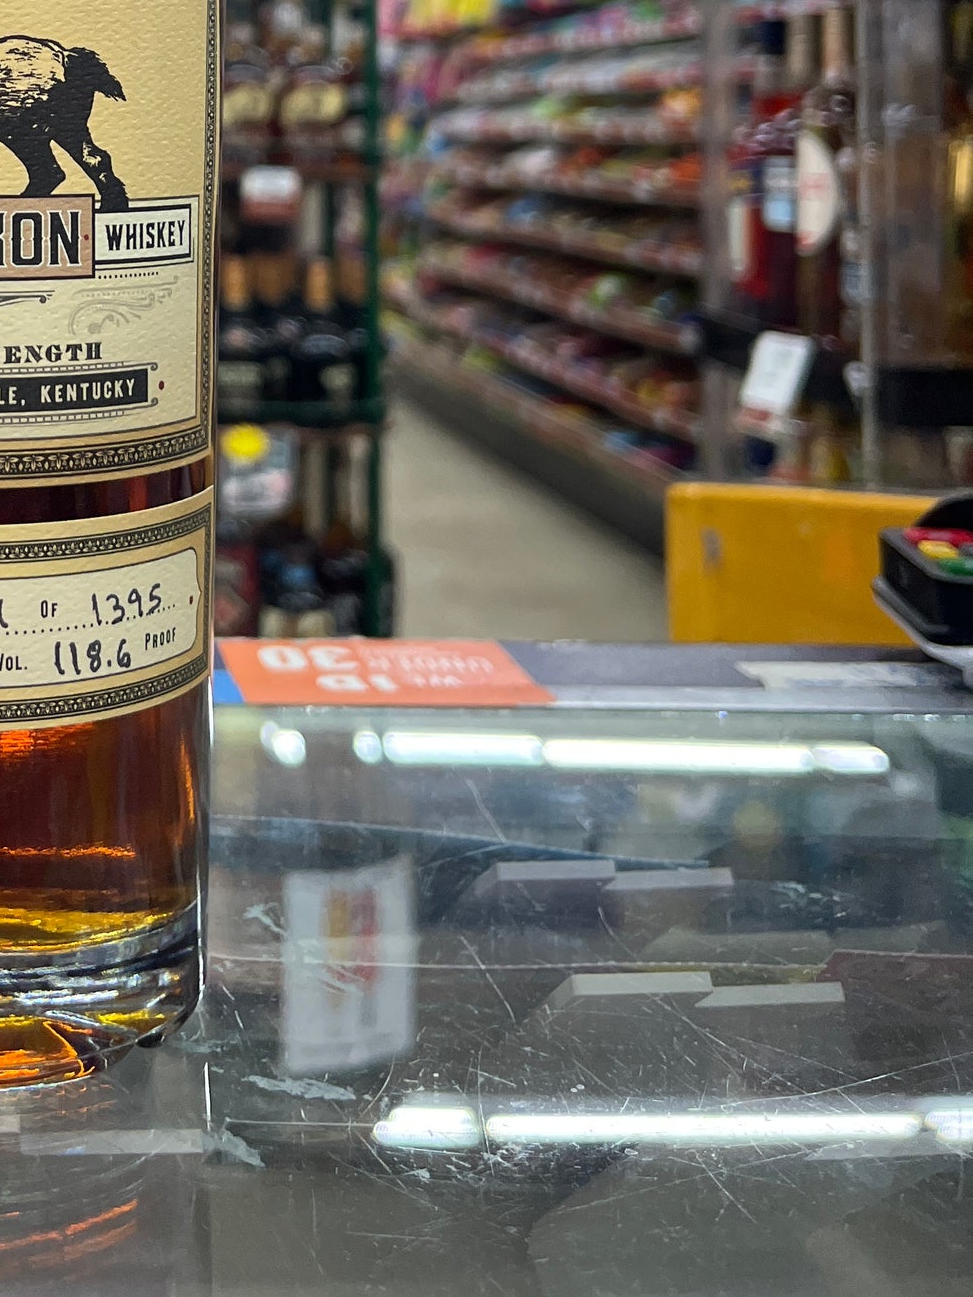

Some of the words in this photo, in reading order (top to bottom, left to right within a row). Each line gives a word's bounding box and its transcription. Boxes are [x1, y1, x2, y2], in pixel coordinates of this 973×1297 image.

[105, 219, 186, 252] WHISKEY
[40, 378, 137, 403] KENTUCKY
[40, 599, 59, 619] OF
[90, 583, 164, 627] 1395
[53, 637, 132, 677] 118.6
[144, 627, 178, 652] PROOF
[256, 645, 359, 672] 30
